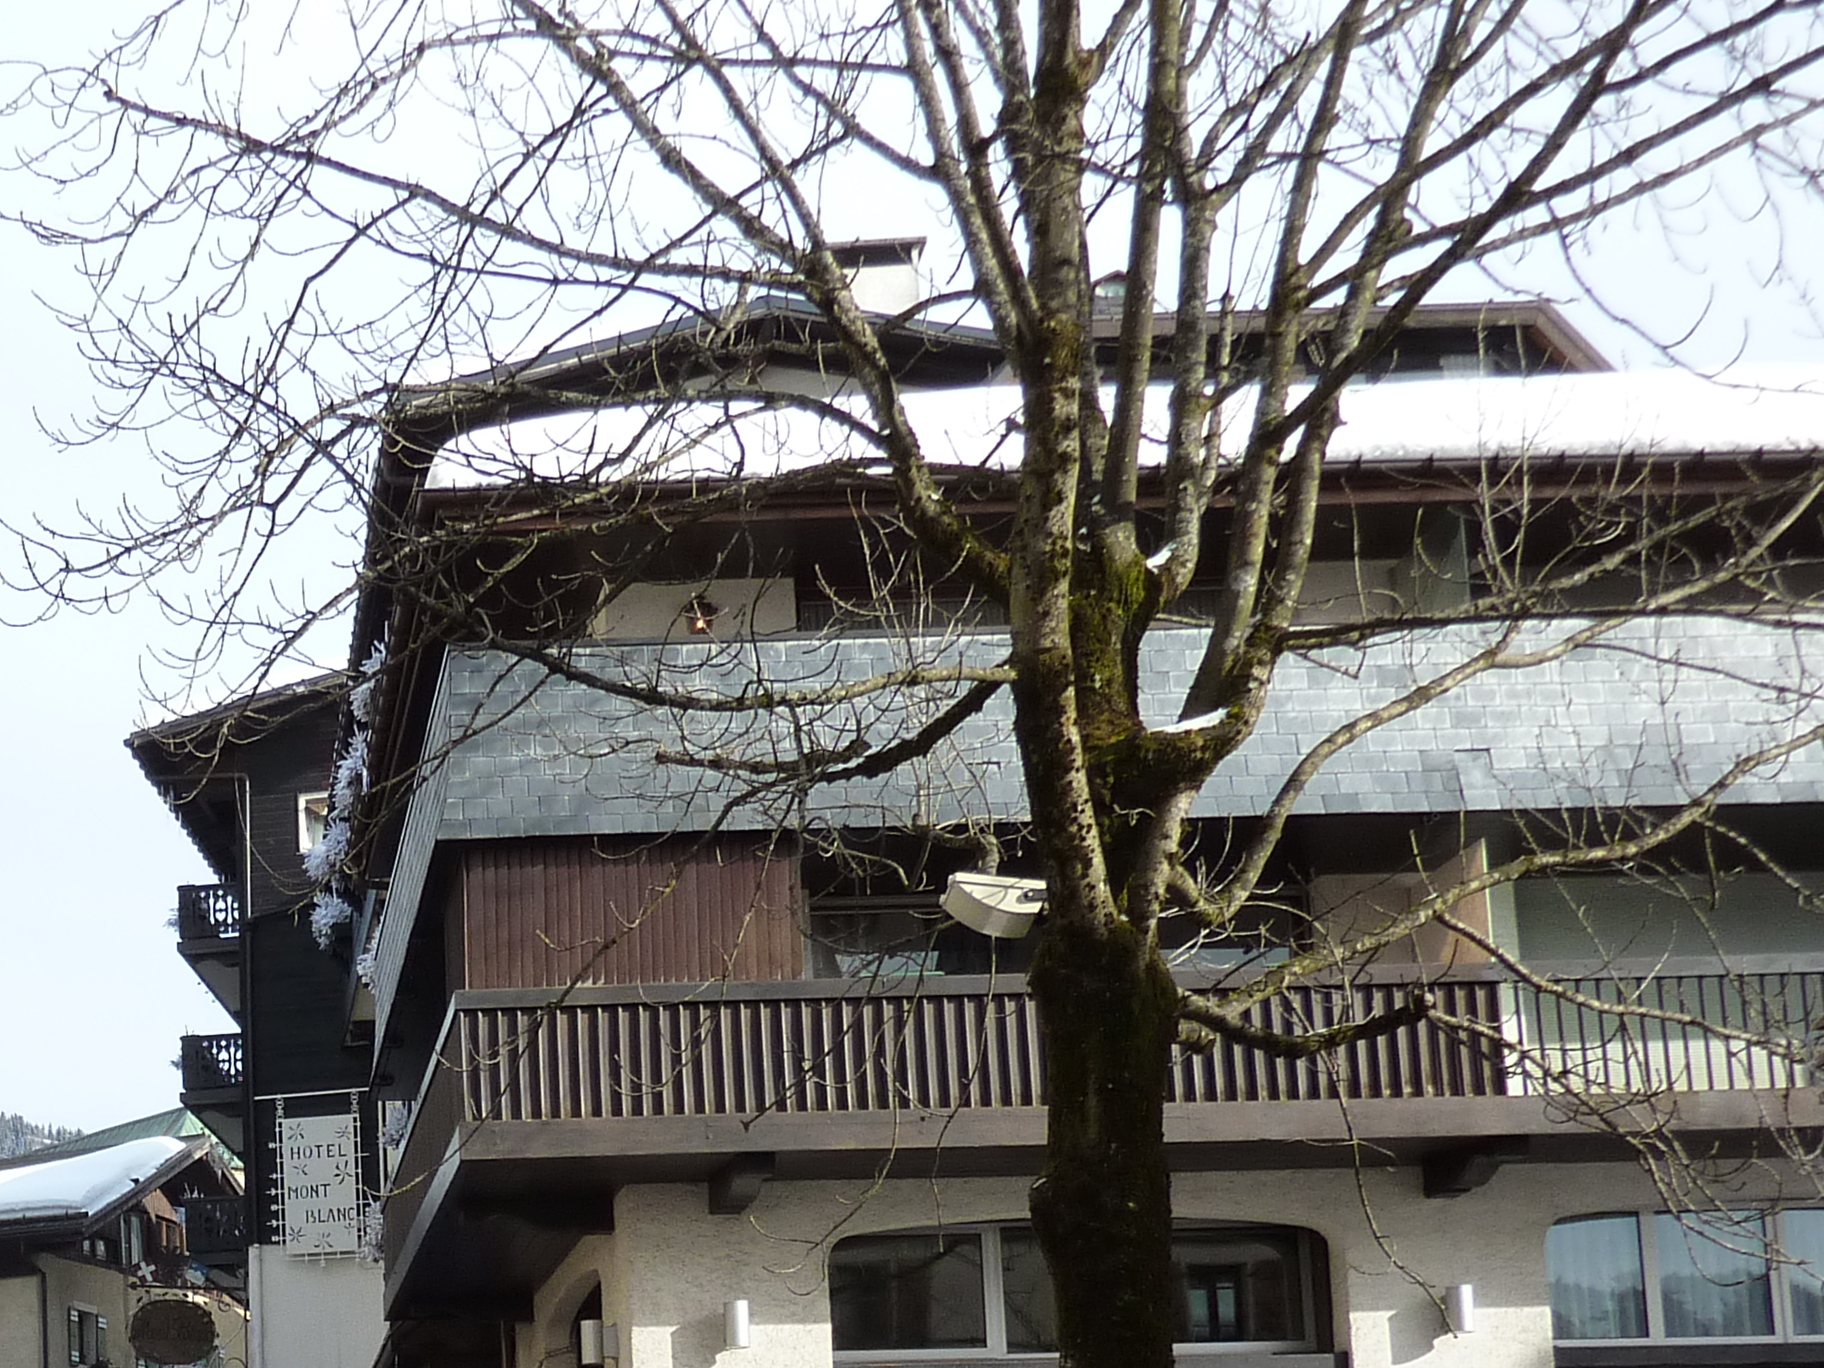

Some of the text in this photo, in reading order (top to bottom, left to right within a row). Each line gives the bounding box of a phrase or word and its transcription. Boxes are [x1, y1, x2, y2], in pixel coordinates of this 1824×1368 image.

[290, 1143, 347, 1160] HOTEL
[287, 1183, 331, 1200] MONT
[305, 1207, 355, 1224] BLANC
